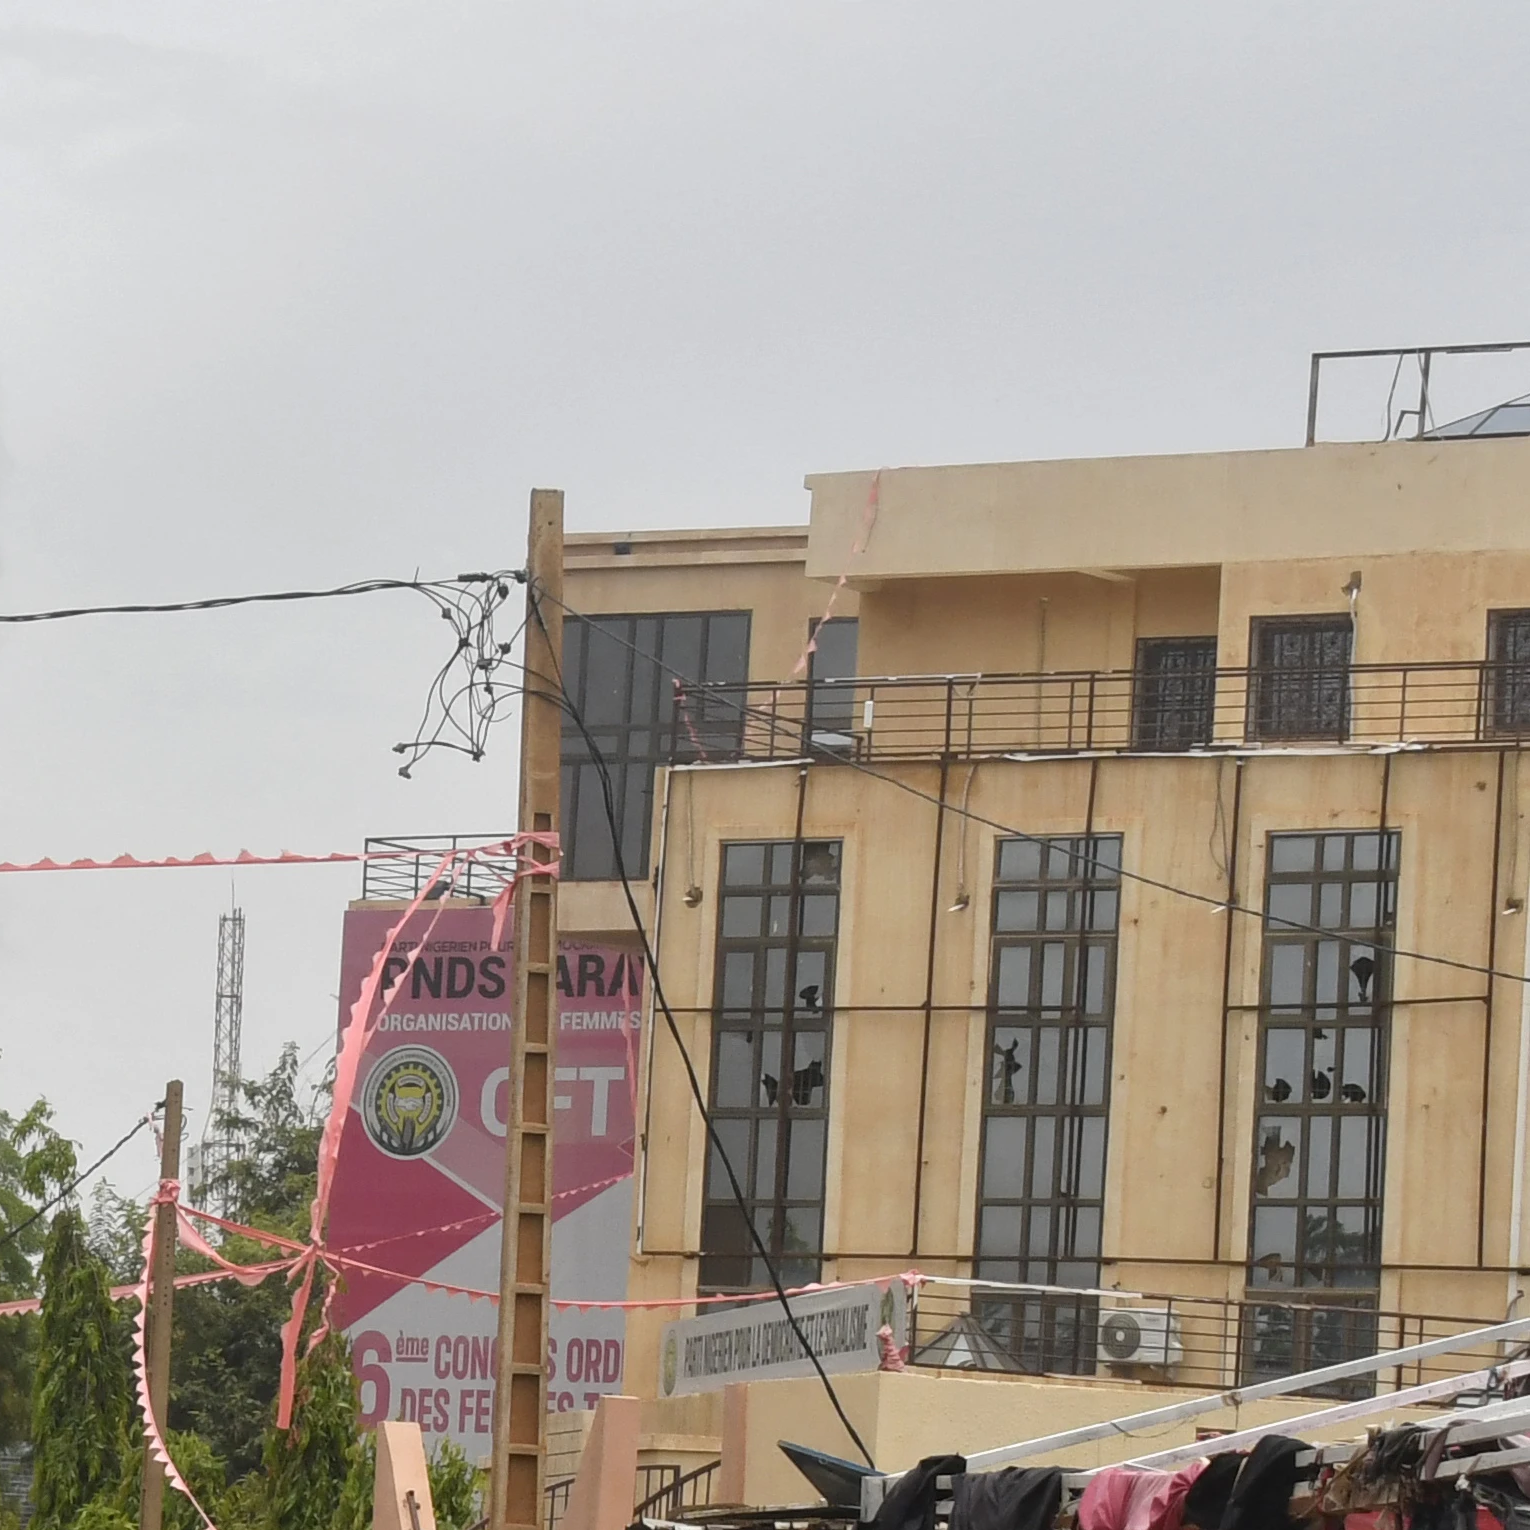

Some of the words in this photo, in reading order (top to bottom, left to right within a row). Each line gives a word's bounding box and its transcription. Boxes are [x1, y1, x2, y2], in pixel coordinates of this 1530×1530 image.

[380, 956, 506, 1000] PNDS
[555, 953, 645, 998] ARA
[434, 1335, 558, 1381] CONS
[400, 1388, 450, 1433] DES
